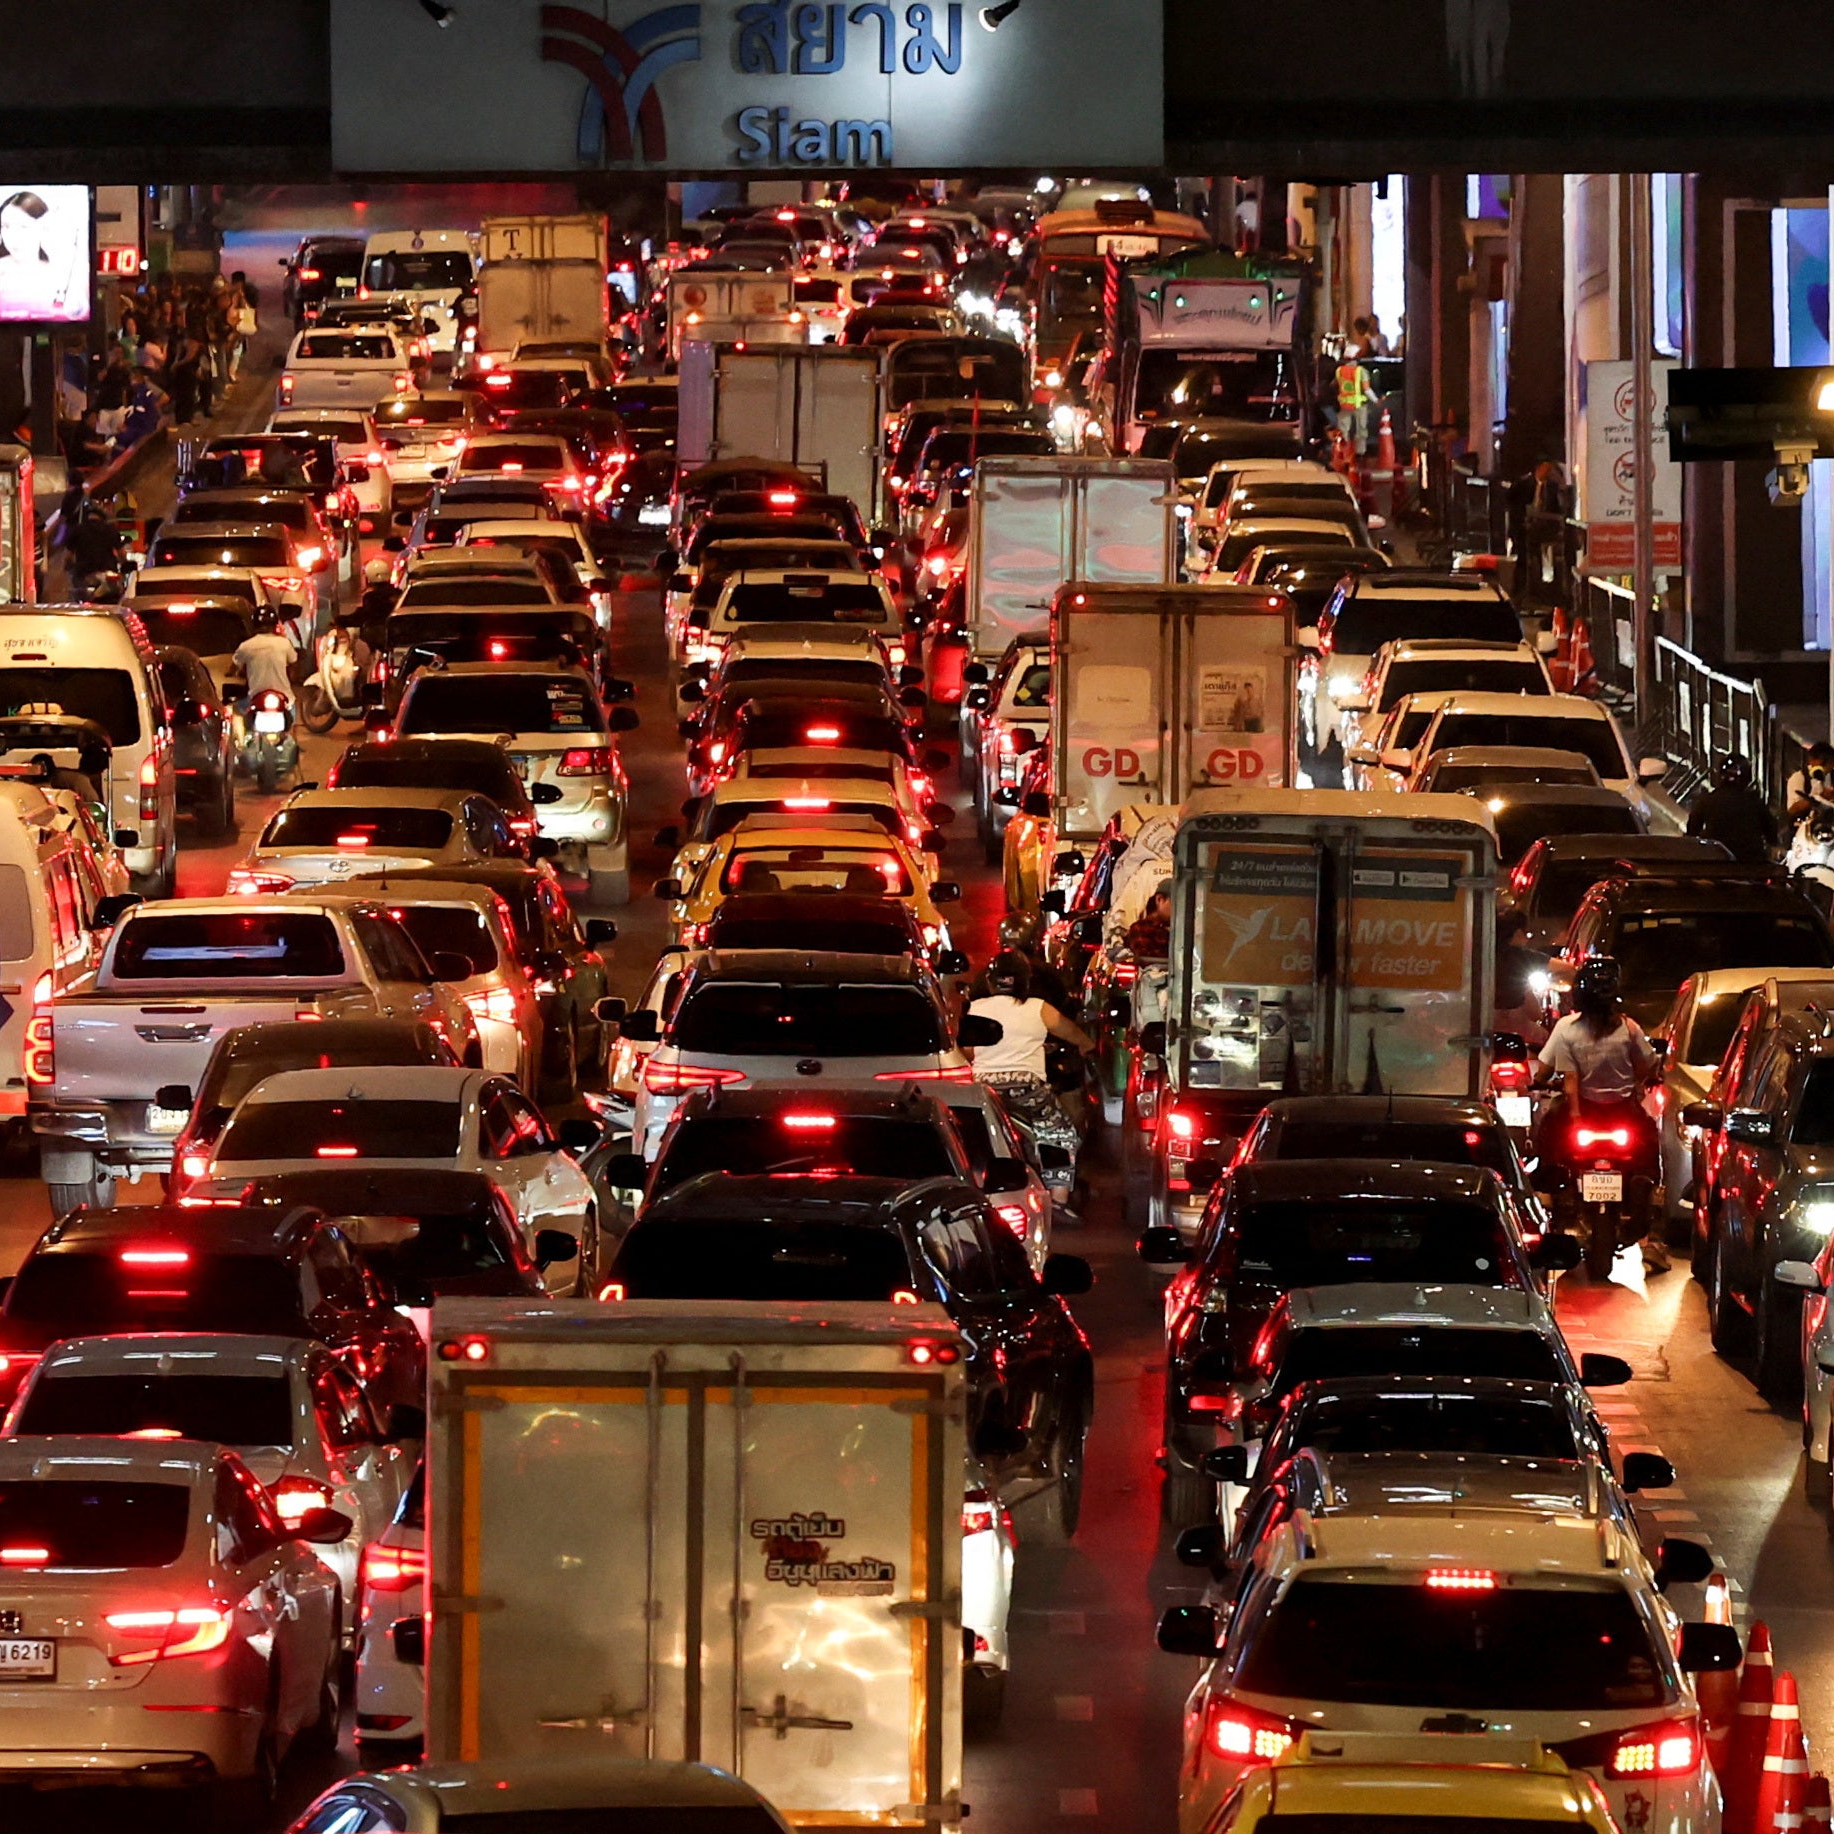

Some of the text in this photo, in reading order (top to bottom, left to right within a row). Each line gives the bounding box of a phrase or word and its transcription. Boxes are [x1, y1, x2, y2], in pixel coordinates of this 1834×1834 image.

[736, 0, 963, 75] สยาม
[737, 105, 893, 164] Siam
[1082, 747, 1140, 777] GD
[1207, 749, 1264, 779] GD
[1371, 953, 1443, 976] faster
[751, 1512, 845, 1541] รถตู้เย็น
[11, 1644, 51, 1660] 6219
